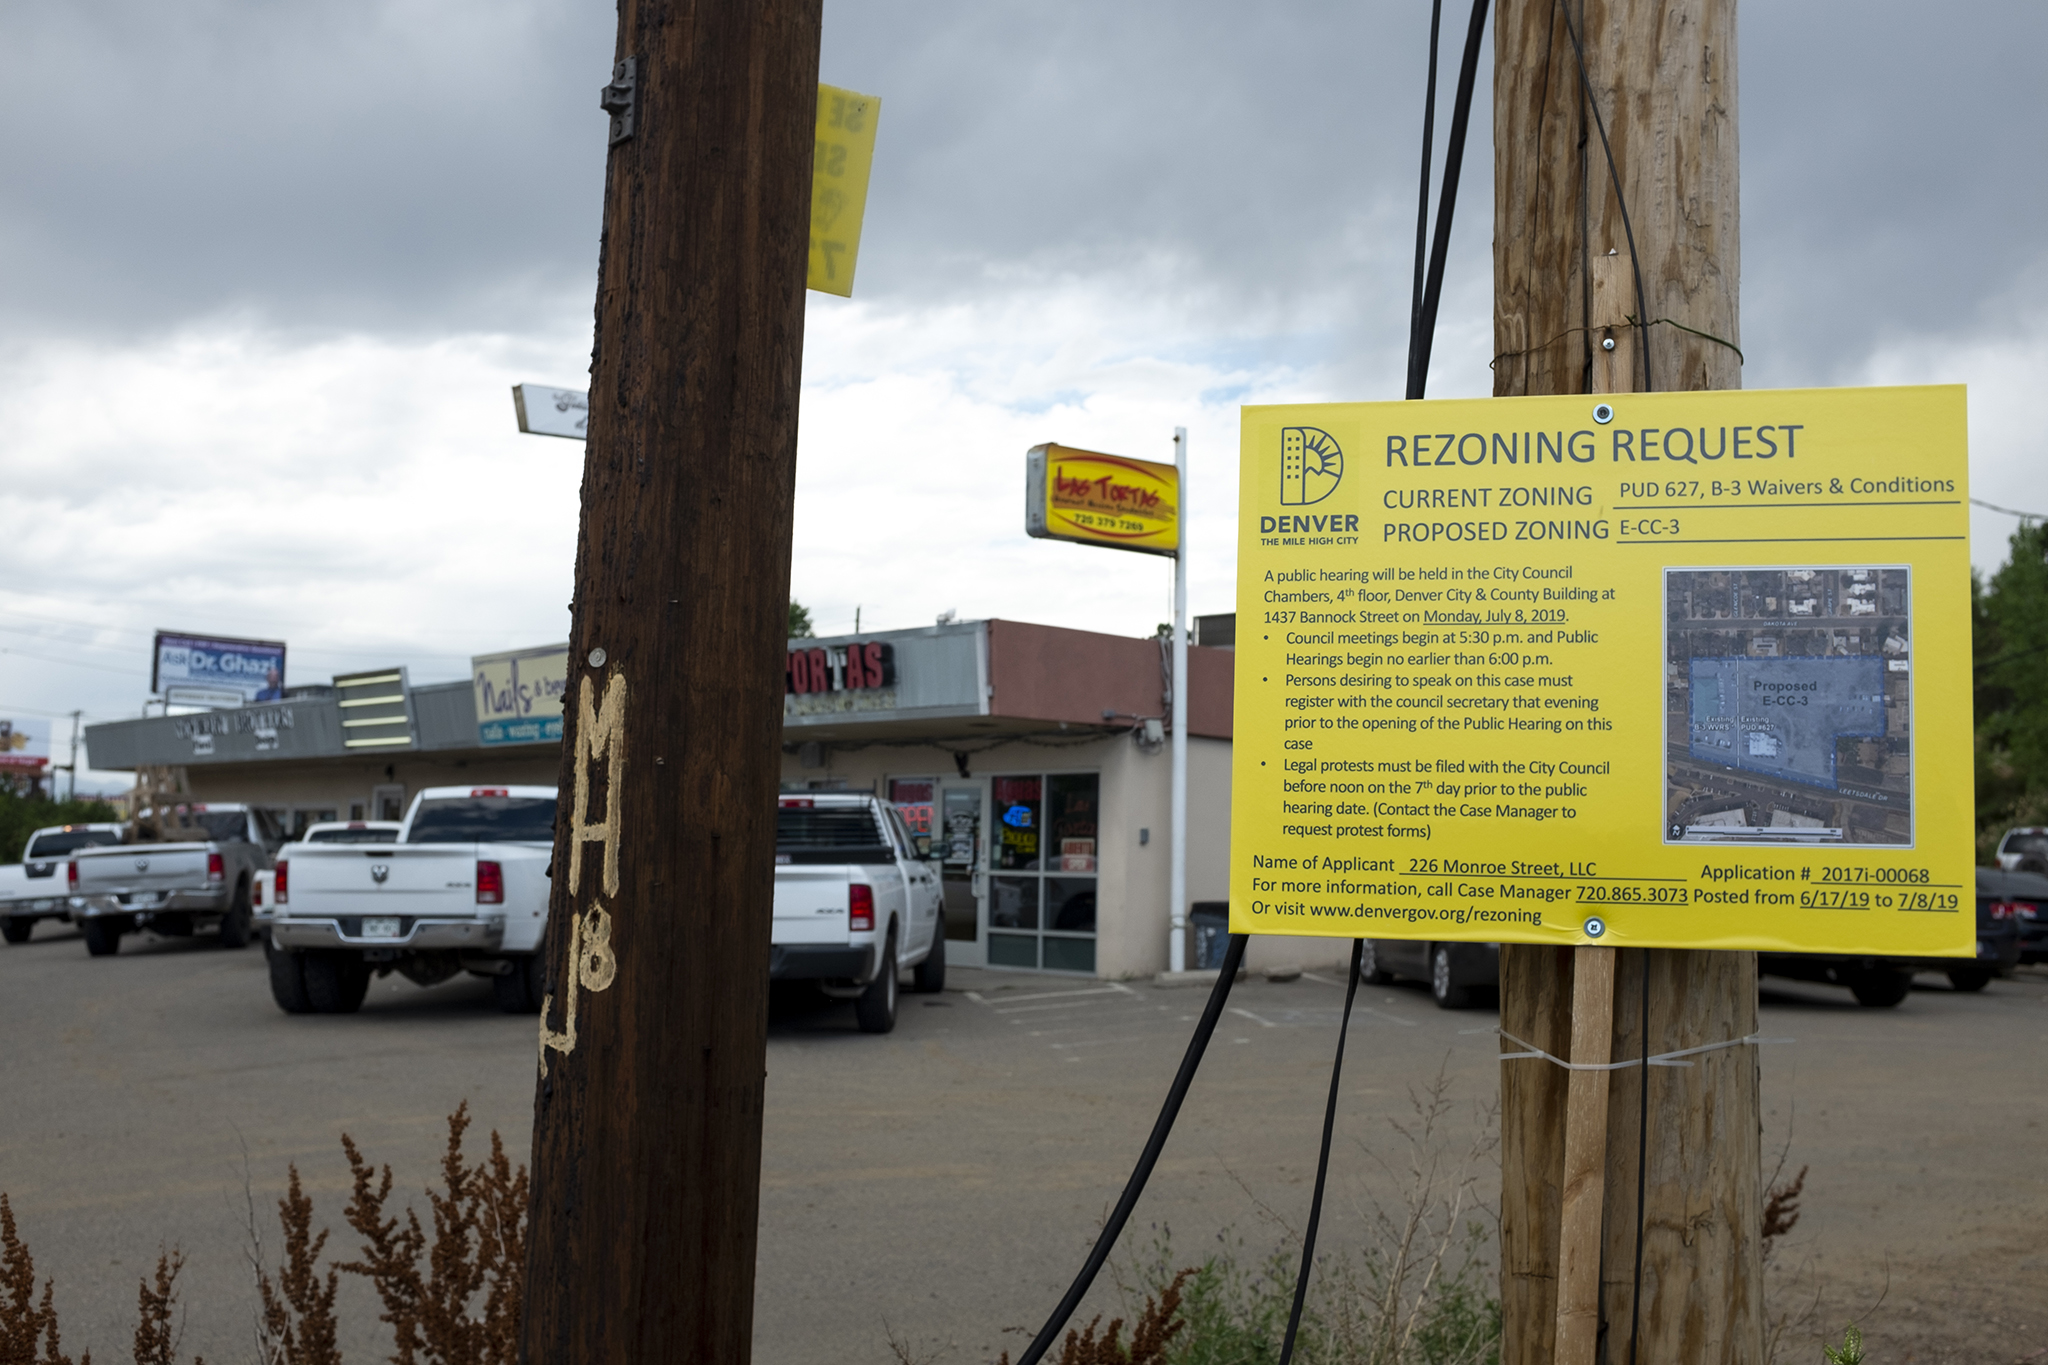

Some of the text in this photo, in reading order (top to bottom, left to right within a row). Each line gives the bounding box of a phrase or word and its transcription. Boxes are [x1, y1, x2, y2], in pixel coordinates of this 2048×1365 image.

[1386, 424, 1805, 468] REZONING REQUEST
[1383, 476, 1955, 510] CURRENT ZONING PUD 627, B-3 Waivers & Conditions
[1260, 513, 1360, 534] DENVER
[1383, 518, 1680, 543] PROPOSED ZONING E-CC-3
[1260, 536, 1359, 547] THE MILE HIGH CITY
[1263, 565, 1573, 585] A public hearing will be held in the City Council
[1263, 589, 1334, 605] Chambers,
[1357, 588, 1392, 605] floor,
[1395, 588, 1444, 602] Denver
[1446, 588, 1473, 605] City
[1475, 587, 1488, 602] &
[1490, 587, 1540, 604] County
[1543, 586, 1599, 604] Building
[1601, 587, 1616, 601] at
[1264, 608, 1569, 624] 1437 Bannock Street on Monday, July 8, 2019.
[1286, 629, 1599, 648] Council meetings begin at 5:30 p.m. and Public
[1286, 651, 1553, 669] Hearings begin no earlier than 6:00 p.m.
[1285, 672, 1574, 690] Persons desiring to speak on this case must
[1753, 680, 1817, 694] Proposed
[1762, 695, 1809, 706] E-CC-3
[1706, 715, 1735, 724] Existing
[1741, 715, 1770, 724] Existing
[1283, 757, 1610, 778] Legal protests must be filed with the City Council
[1283, 778, 1327, 794] before
[1329, 782, 1365, 794] noon
[1367, 783, 1386, 794] on
[1388, 780, 1412, 795] the
[1435, 780, 1462, 799] day
[1463, 781, 1498, 799] prior
[1499, 783, 1516, 796] to
[1517, 781, 1542, 797] the
[1545, 782, 1588, 800] public
[1839, 788, 1877, 800] LEETSDALE
[1282, 799, 1577, 822] hearing date. (Contact the Case Manager to
[1253, 854, 1597, 877] Name of Applicant 226 Monroe Street, LLC
[1700, 864, 1930, 884] Application # 2017i-00068
[1252, 877, 1959, 910] For more information, call Case Manager 720.865.3073 Posted from 6/17/19 to 7/8/19
[1251, 900, 1542, 927] Or visit www.denvergov.org/rezoning
